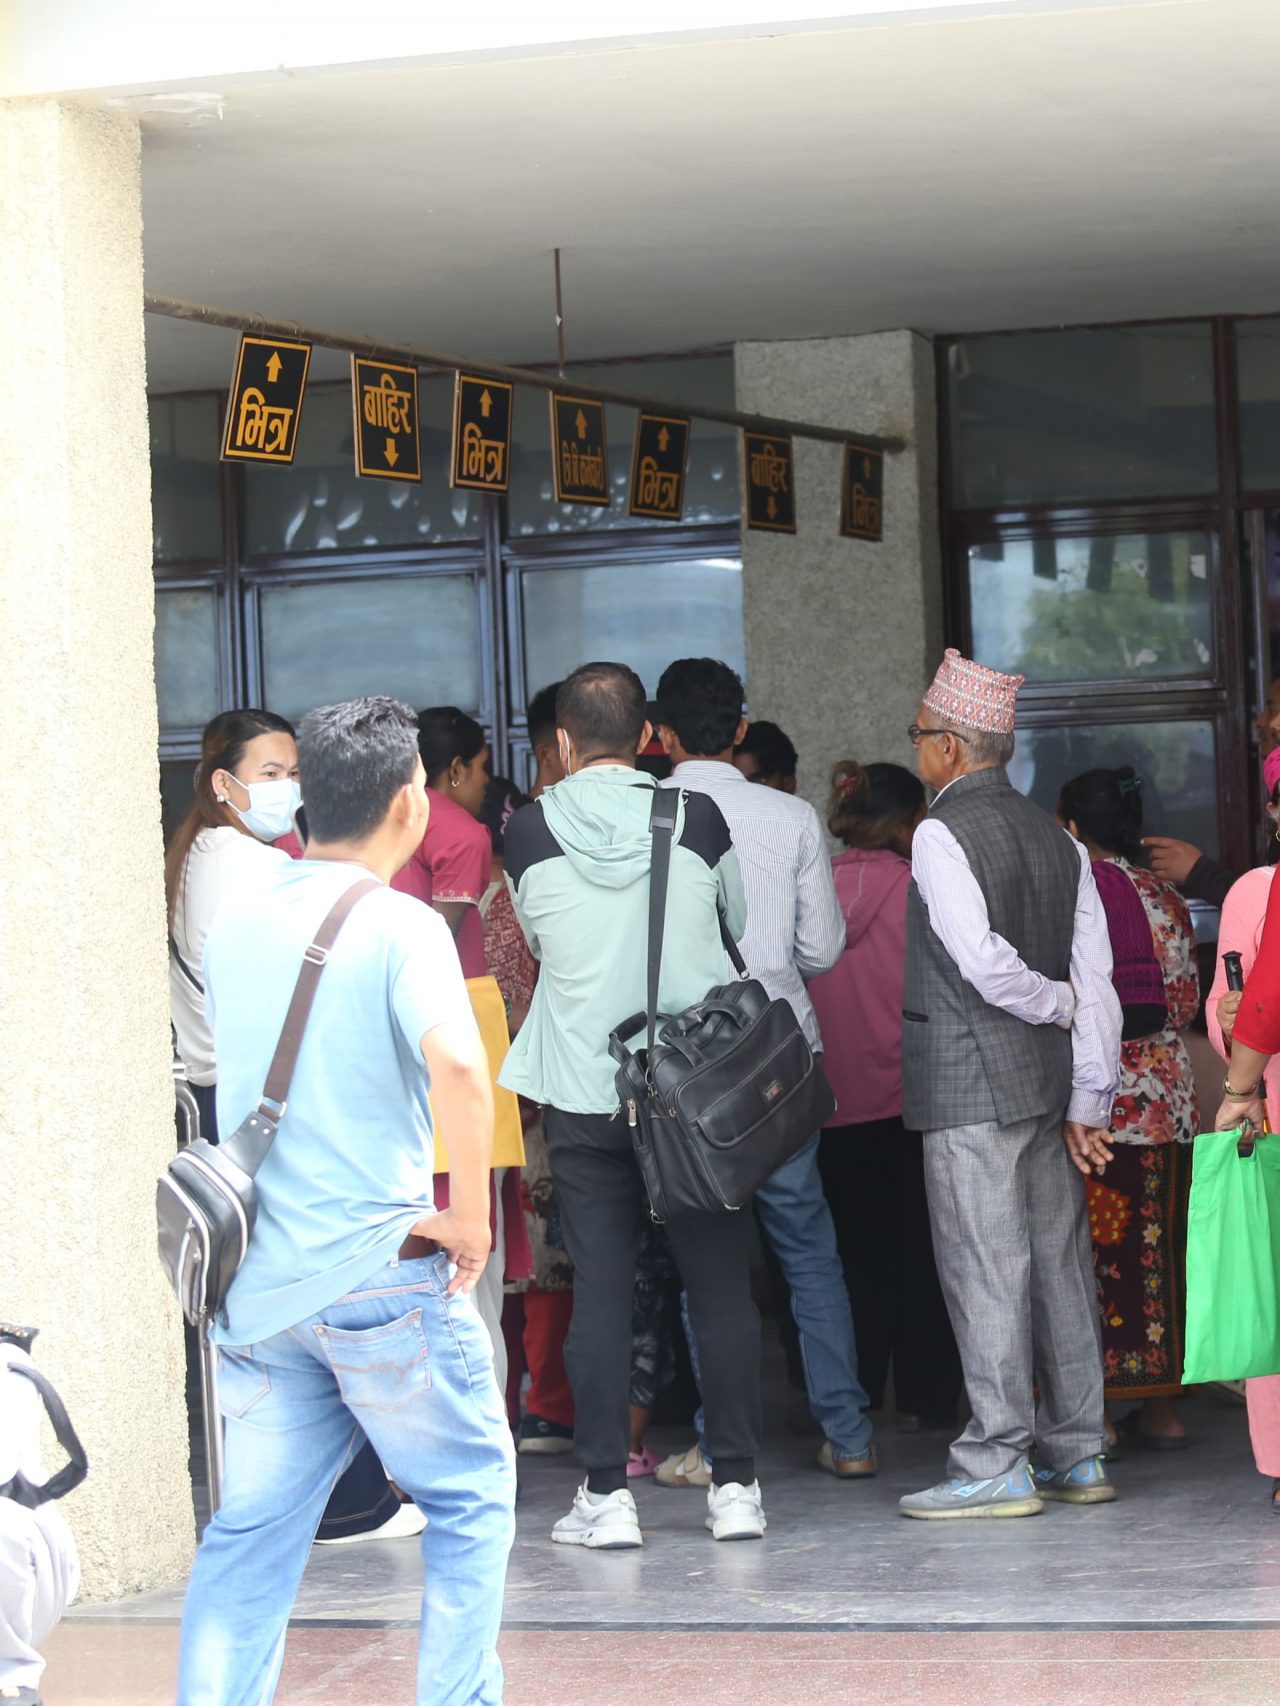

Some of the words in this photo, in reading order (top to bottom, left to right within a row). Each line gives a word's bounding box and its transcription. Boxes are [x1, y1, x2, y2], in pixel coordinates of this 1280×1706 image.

[236, 387, 293, 452] भित्र
[363, 373, 412, 434] बाहिर
[463, 422, 505, 482] भित्र
[751, 442, 788, 493] बाहिर
[638, 455, 680, 510] भित्र
